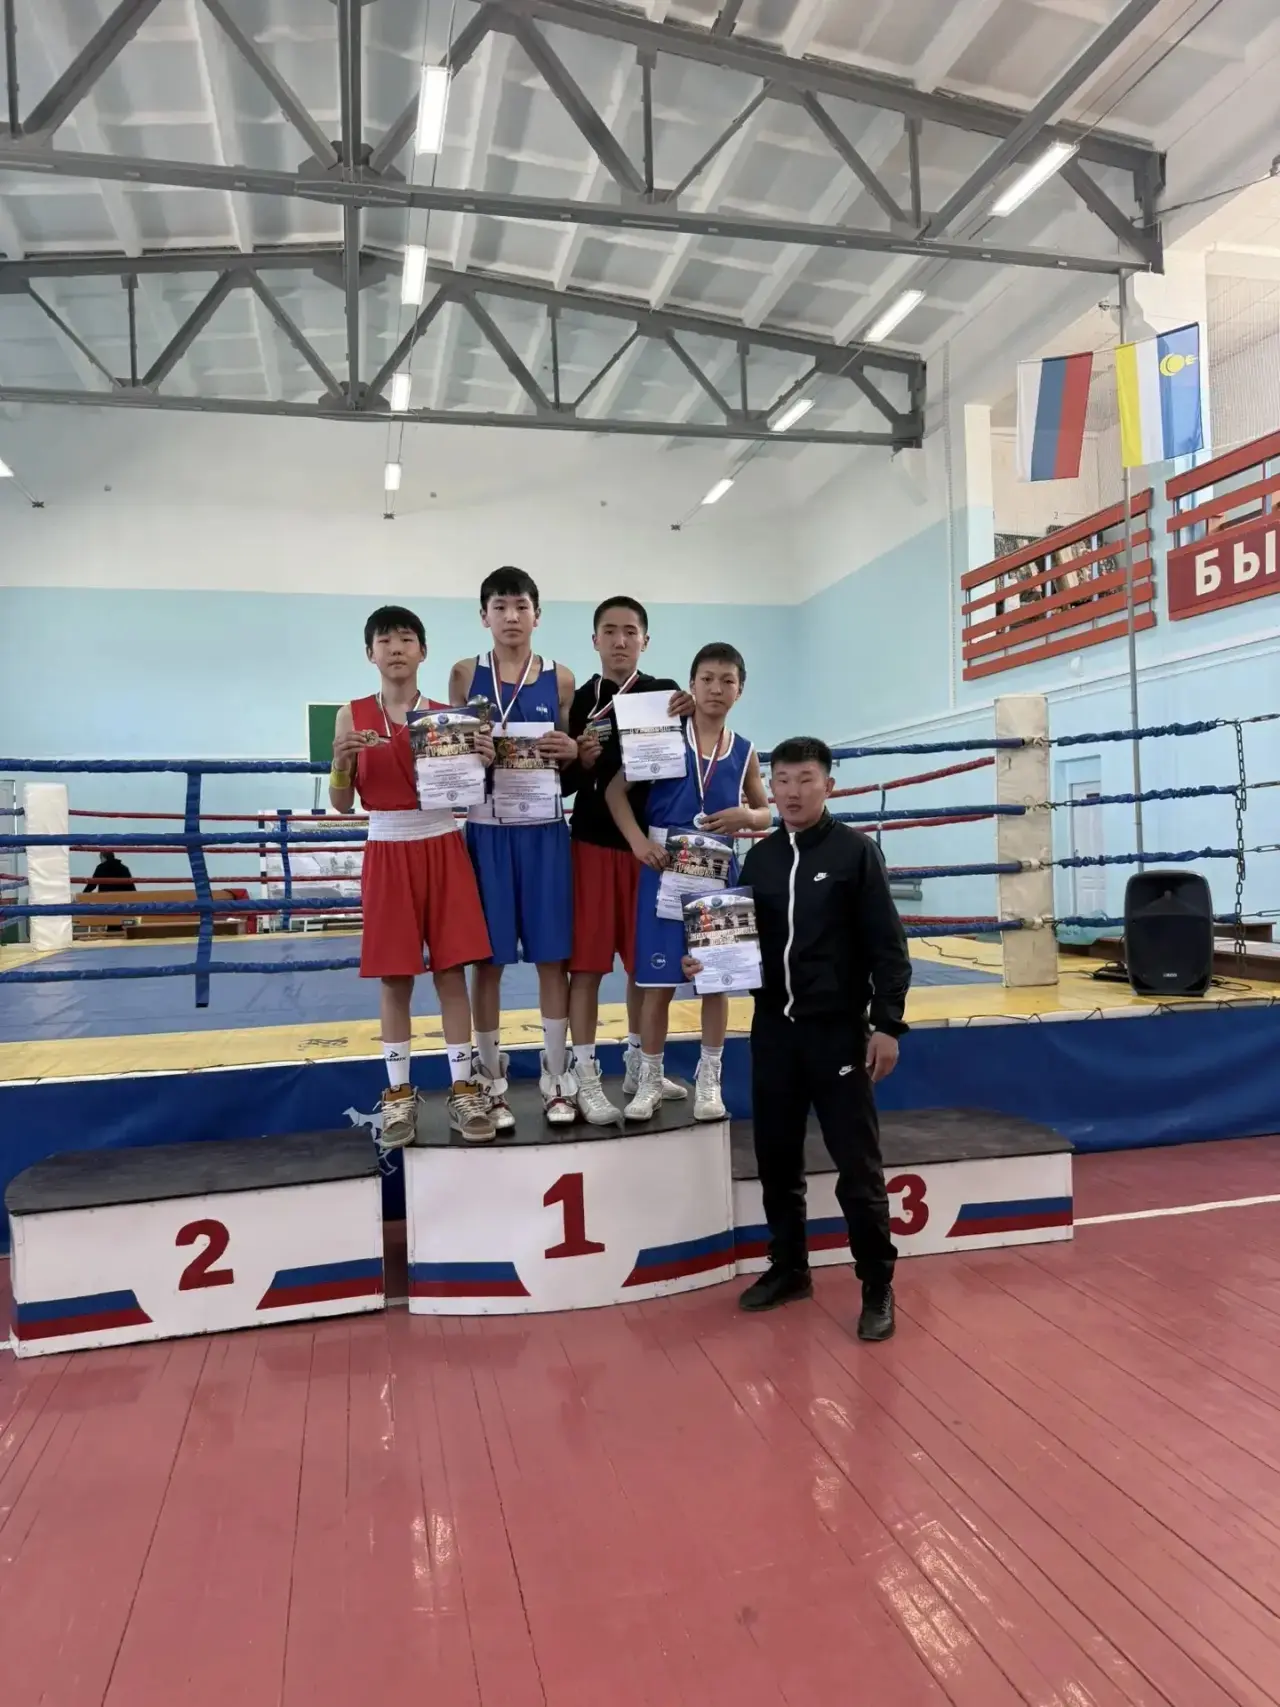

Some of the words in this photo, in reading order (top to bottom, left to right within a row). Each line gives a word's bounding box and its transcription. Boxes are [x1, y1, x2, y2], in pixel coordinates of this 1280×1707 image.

[1195, 530, 1276, 596] БЫ
[543, 1173, 605, 1259] 1
[886, 1174, 929, 1235] 3
[175, 1219, 235, 1291] 2
